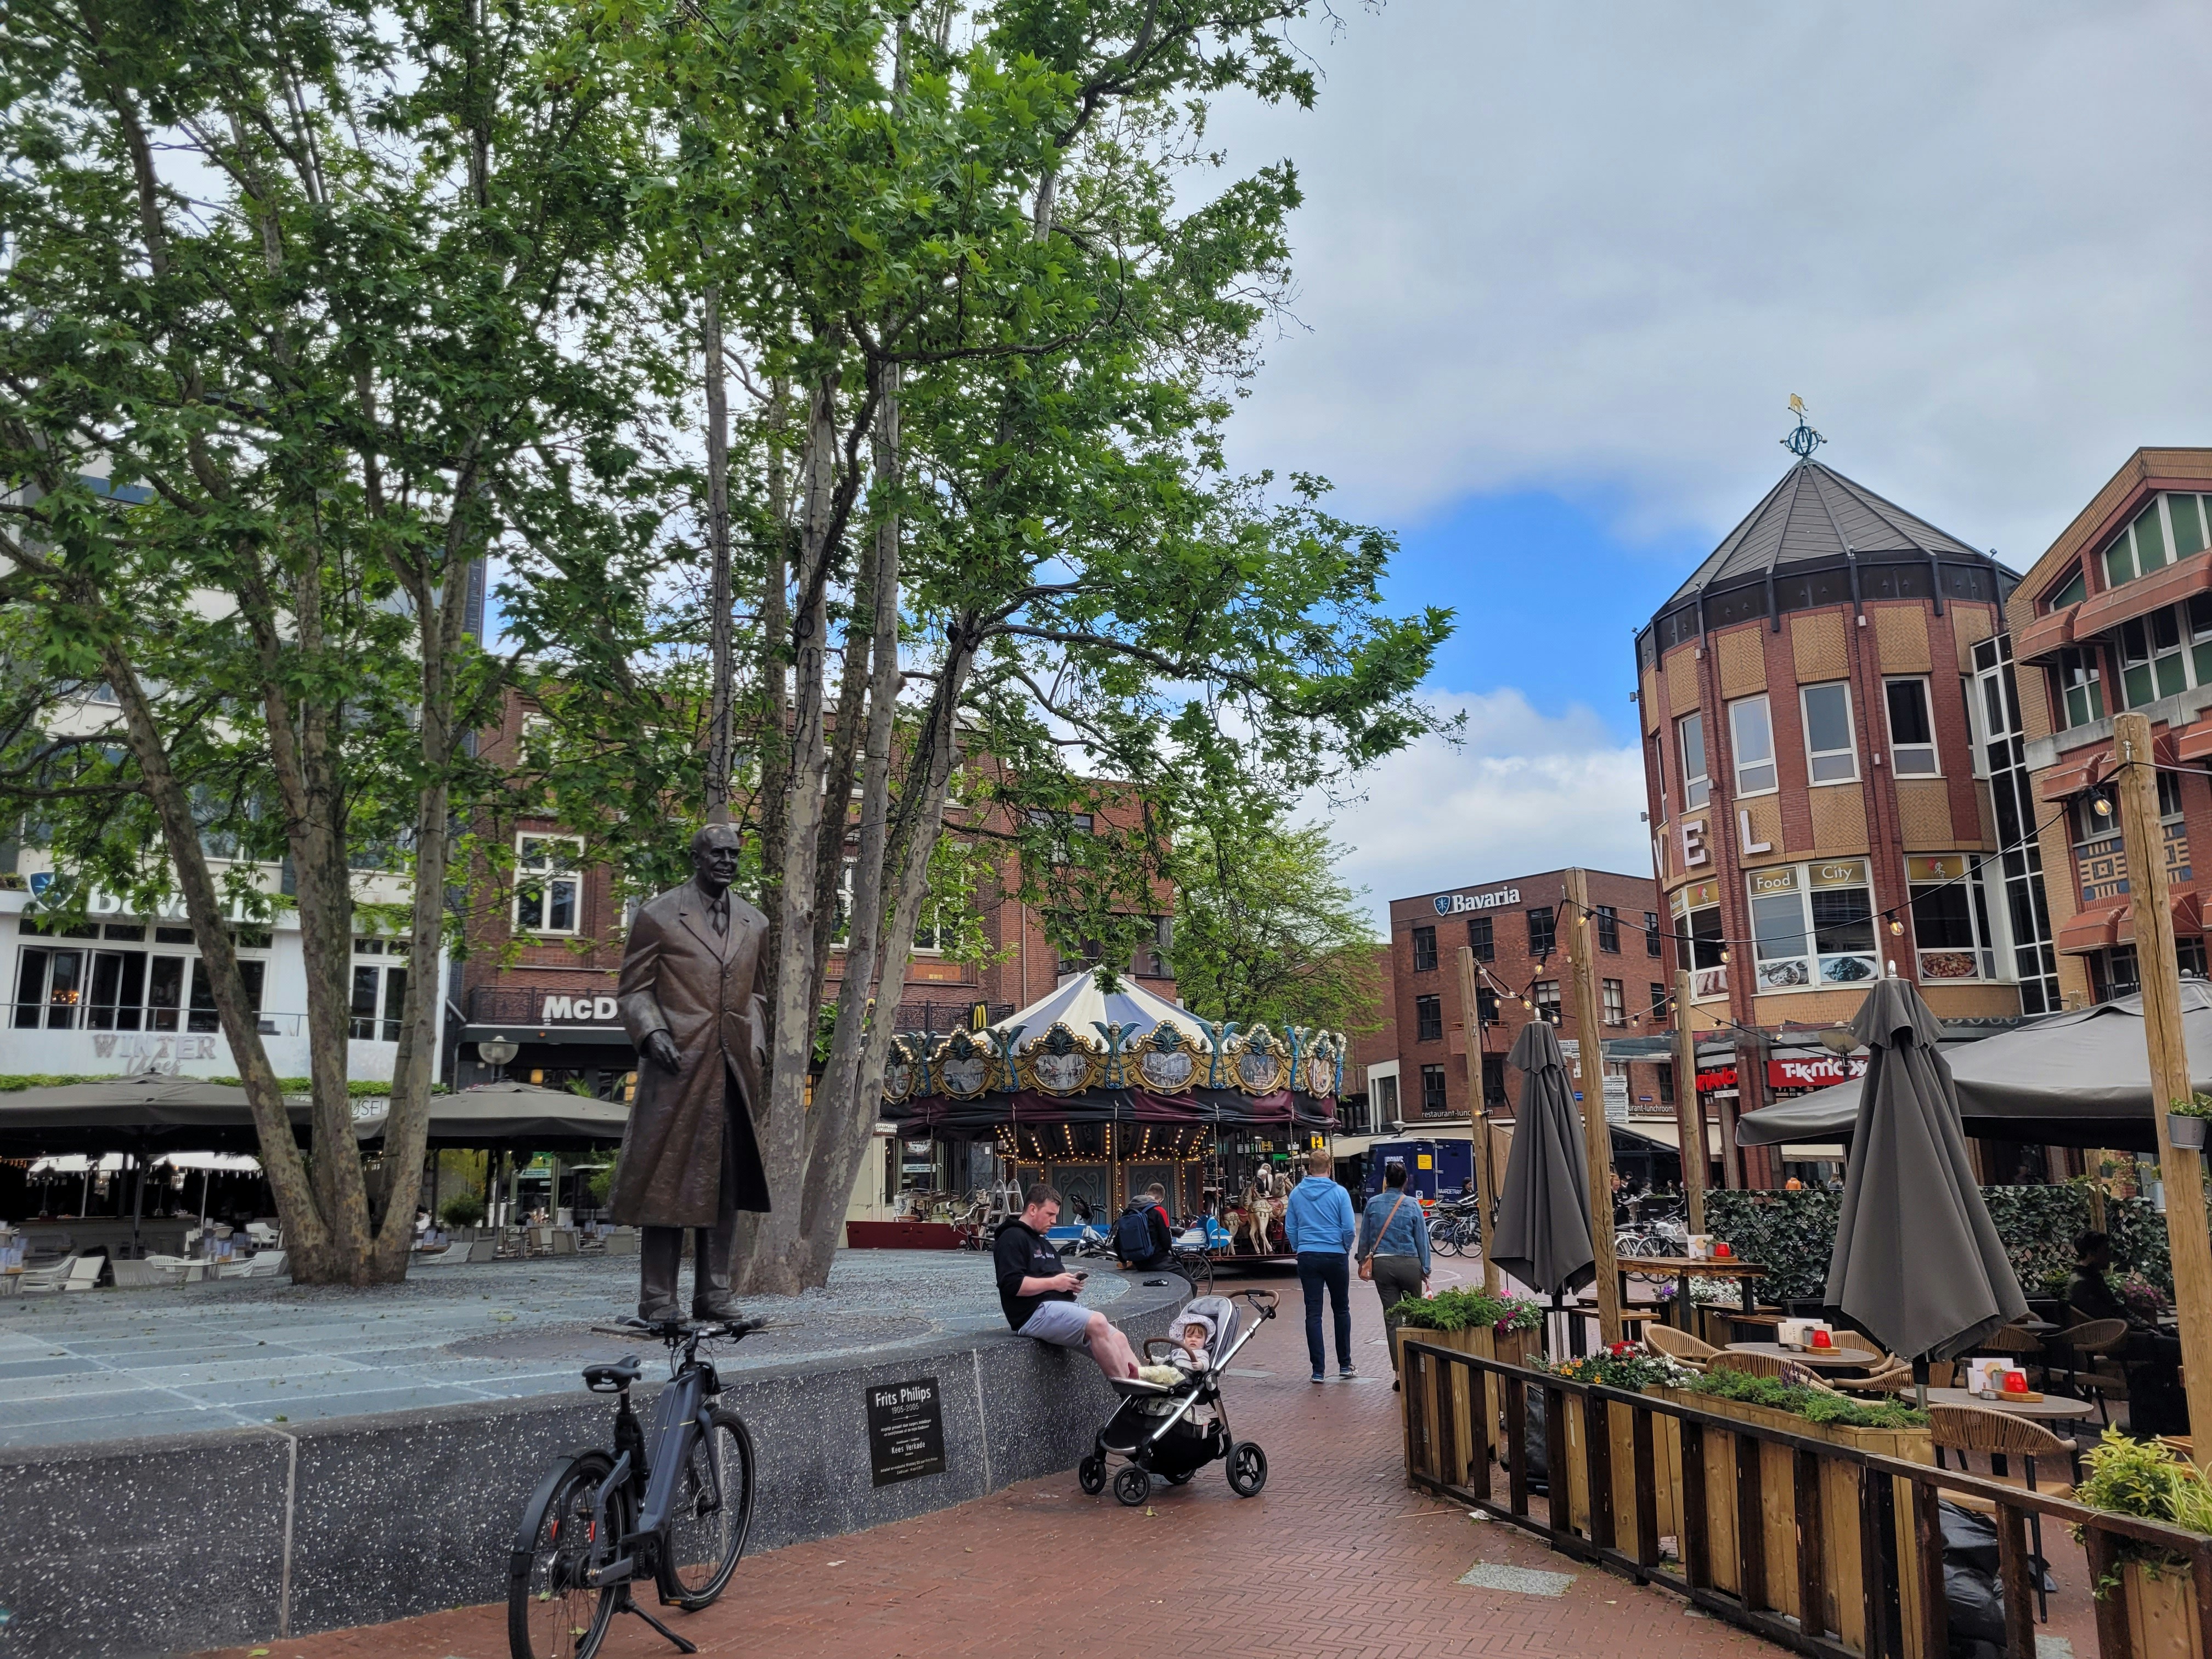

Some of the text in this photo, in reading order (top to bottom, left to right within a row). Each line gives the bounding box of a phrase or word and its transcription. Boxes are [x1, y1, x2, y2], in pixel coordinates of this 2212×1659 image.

[1757, 866, 1853, 890] Food City
[1452, 885, 1521, 913] Bavaria
[541, 996, 618, 1019] McD
[92, 1034, 217, 1059] WINTER
[876, 1386, 932, 1407] Frits Philips
[891, 1403, 919, 1414] 1905-2005
[891, 1441, 926, 1454] Kees Verkade
